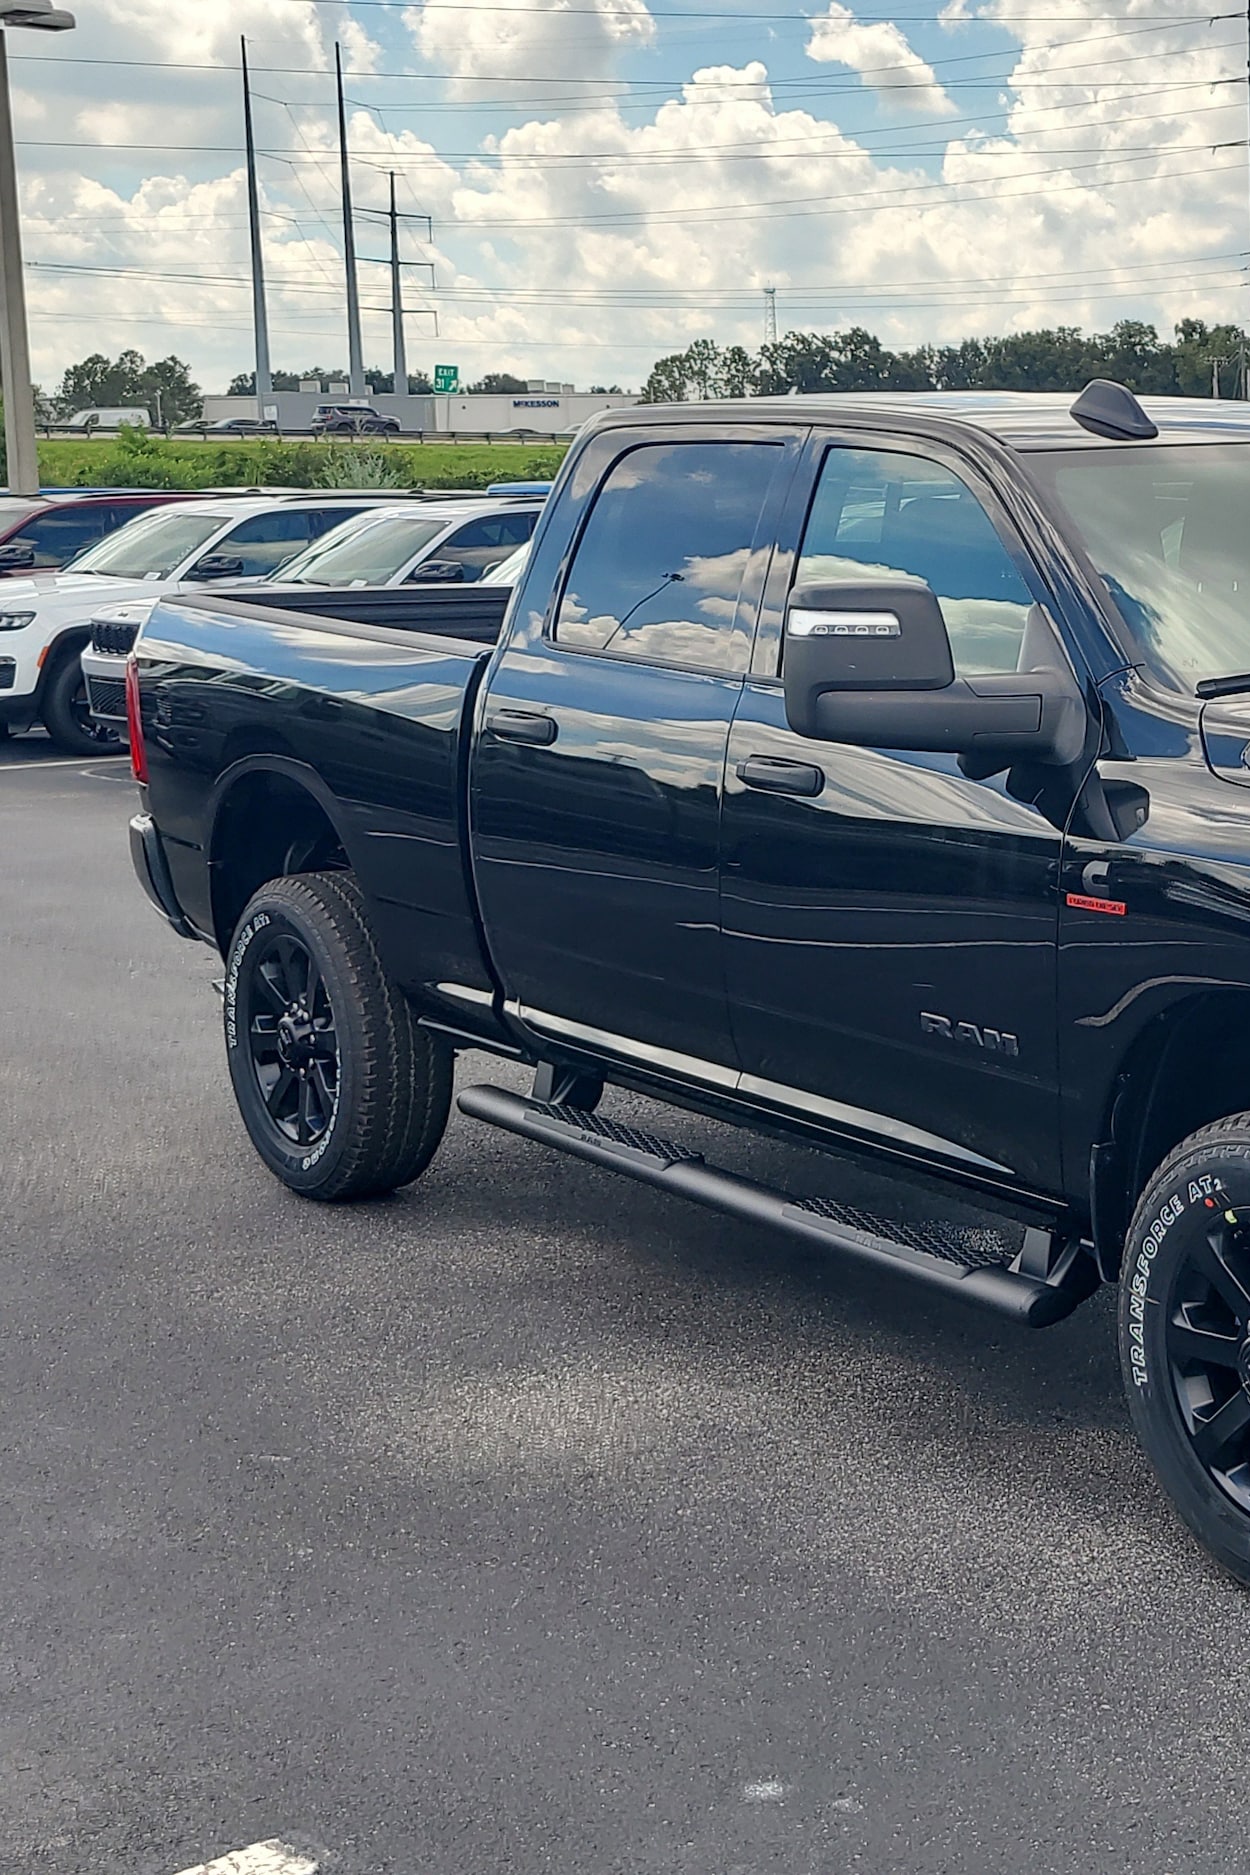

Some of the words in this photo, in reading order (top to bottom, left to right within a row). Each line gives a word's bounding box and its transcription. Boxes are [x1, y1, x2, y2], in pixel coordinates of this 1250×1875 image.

[436, 378, 445, 389] 31
[438, 368, 455, 377] EXIT
[920, 1011, 1019, 1057] RAM
[1128, 1193, 1185, 1387] TRANSFORCE
